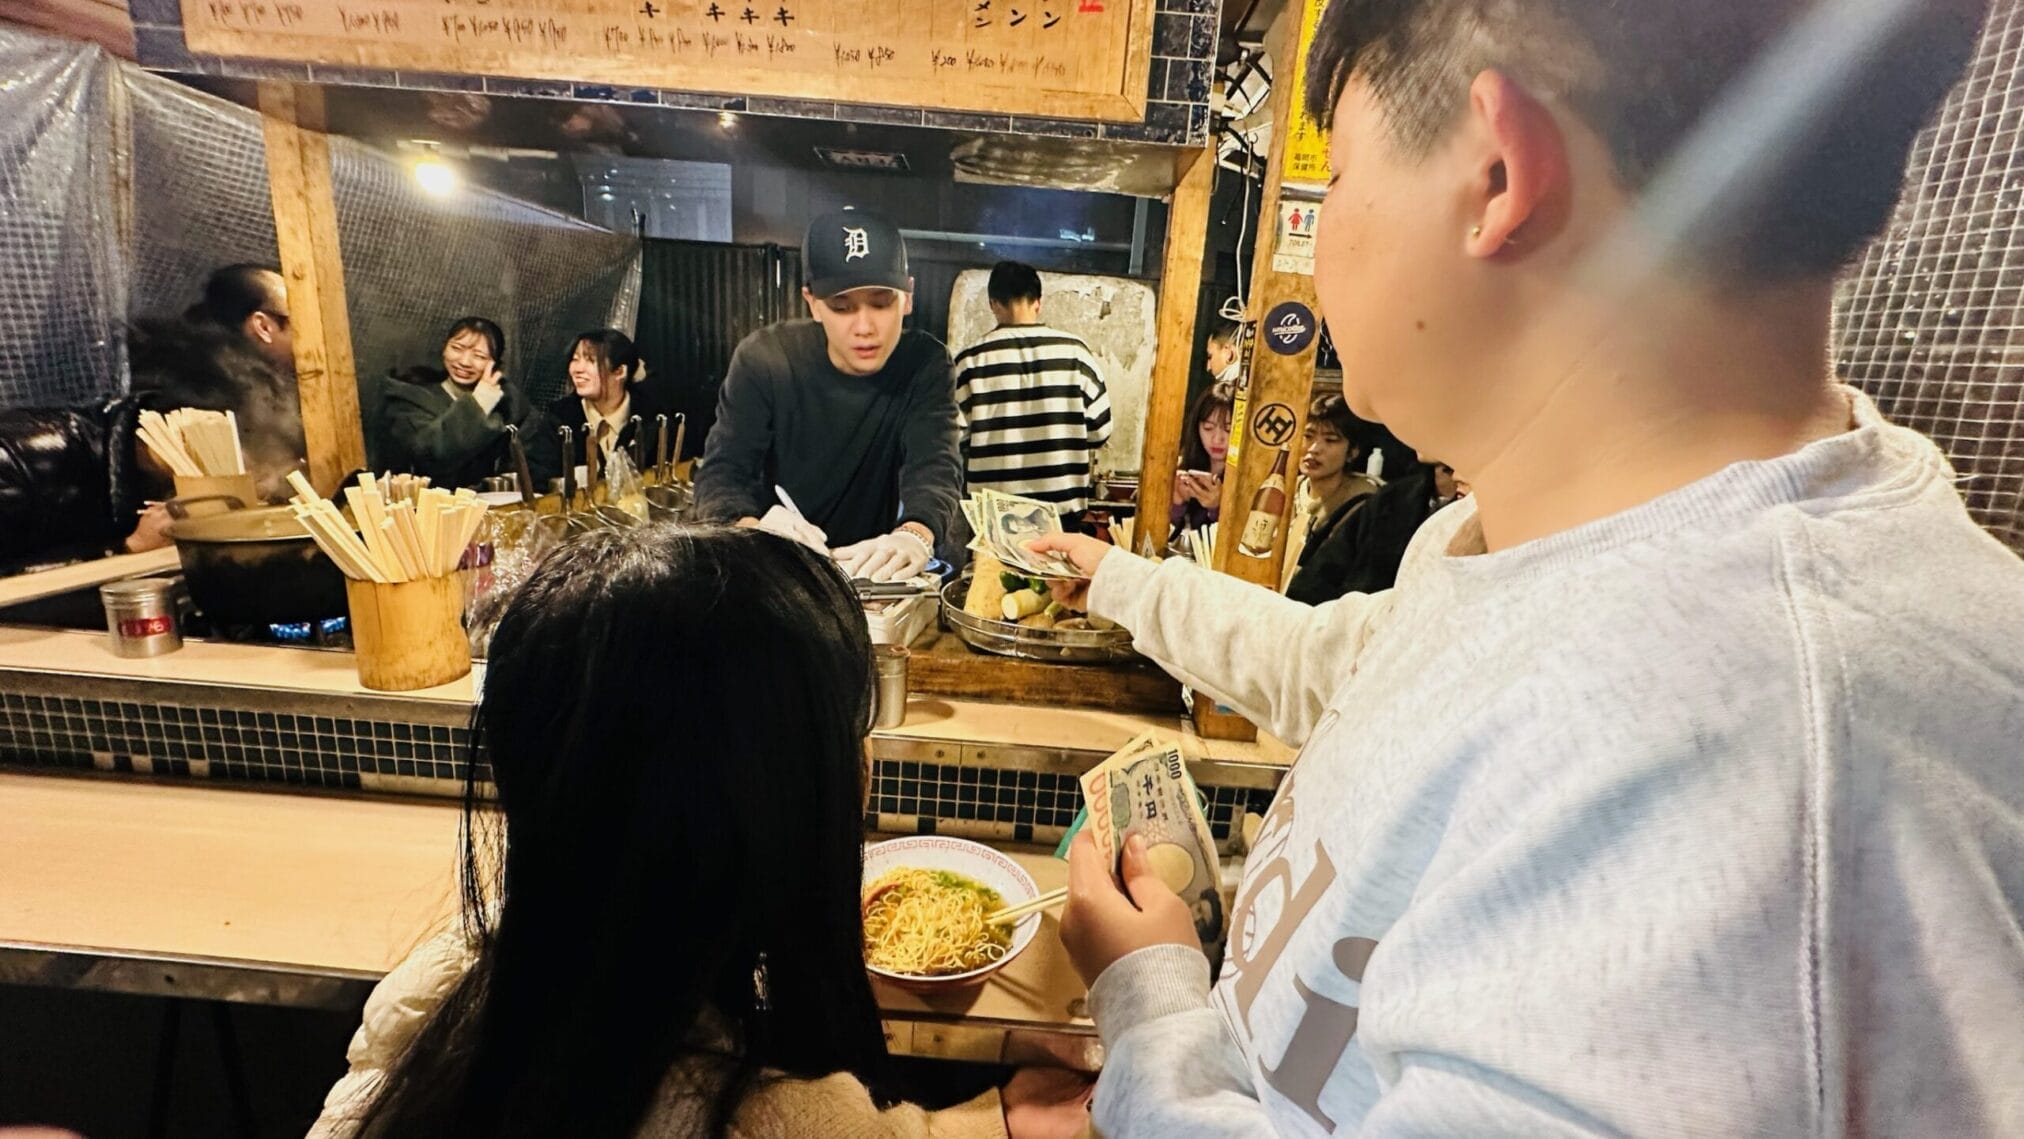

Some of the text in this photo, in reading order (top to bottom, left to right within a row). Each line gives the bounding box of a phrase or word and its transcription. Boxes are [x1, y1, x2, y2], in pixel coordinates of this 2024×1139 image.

[705, 2, 726, 23] キ
[739, 7, 760, 25] キ
[773, 6, 796, 27] キ
[842, 226, 871, 263] D
[1166, 748, 1183, 781] 1000
